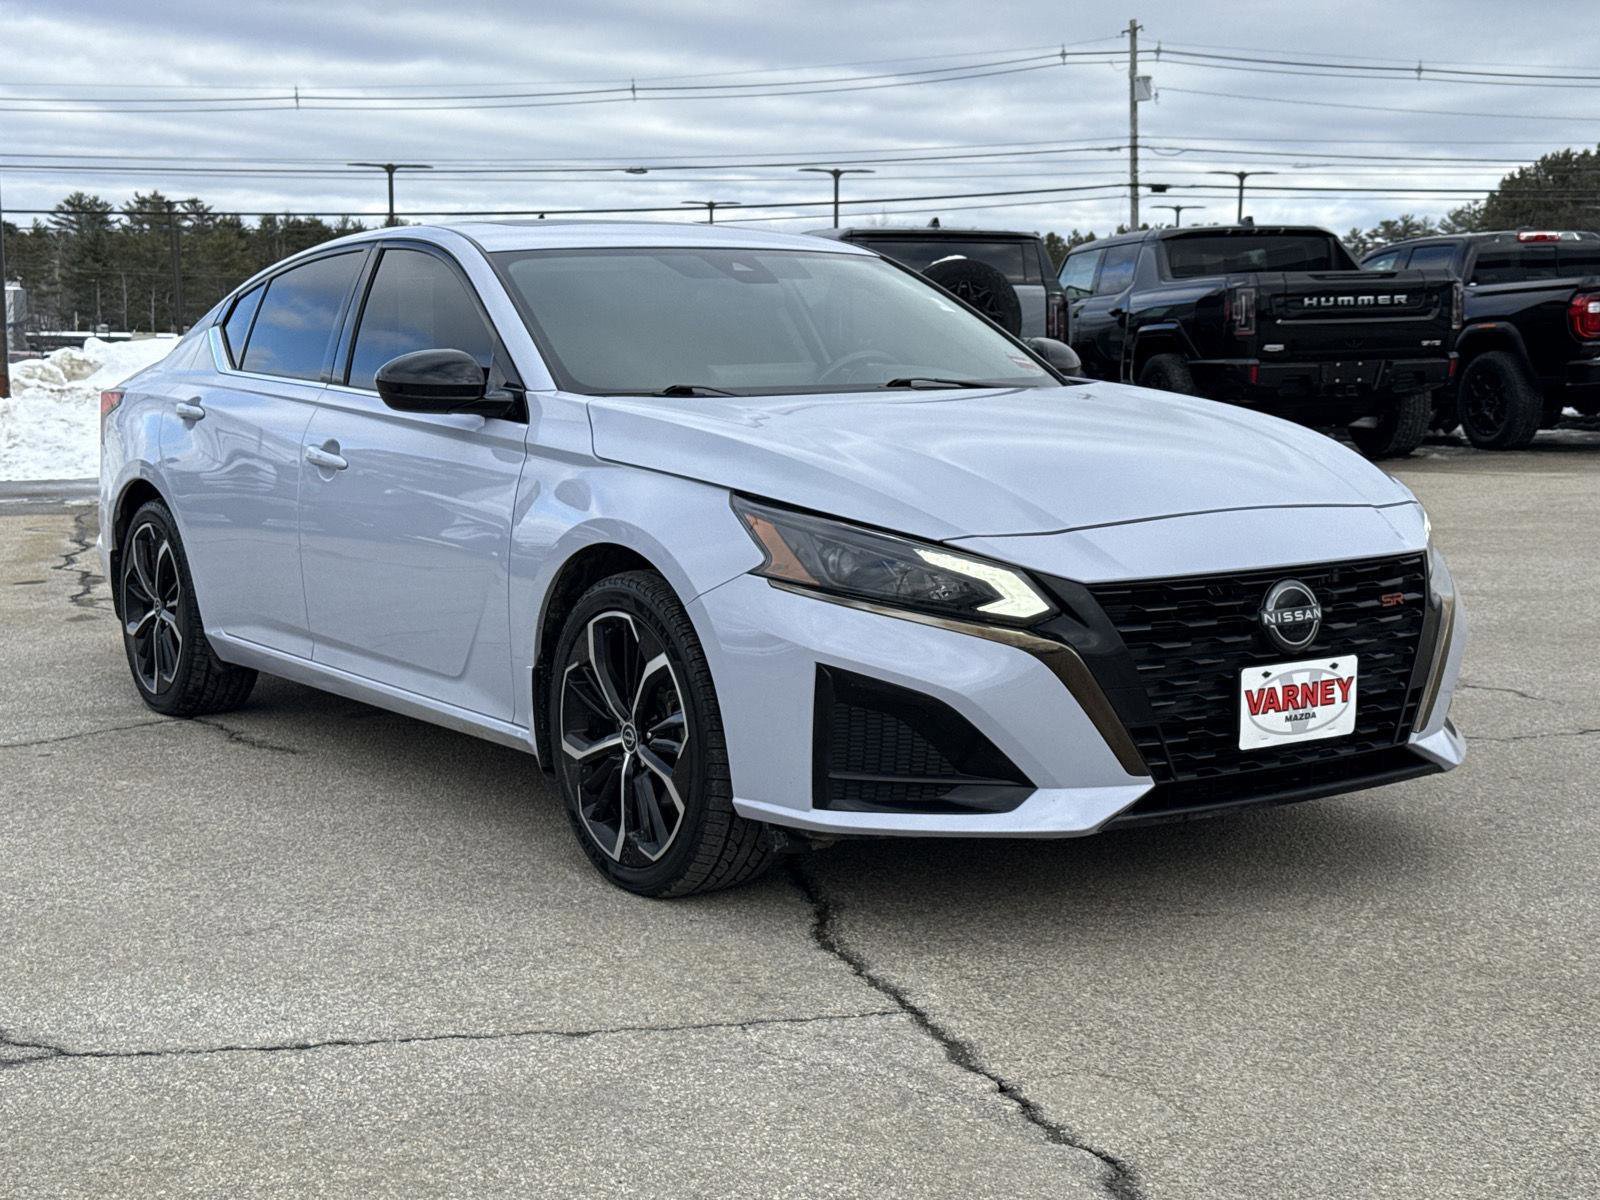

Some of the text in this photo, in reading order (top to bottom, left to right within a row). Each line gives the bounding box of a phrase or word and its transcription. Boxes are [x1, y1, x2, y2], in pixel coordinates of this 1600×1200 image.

[1303, 294, 1408, 306] HUMMER
[1263, 607, 1322, 624] NISSAN
[1244, 676, 1355, 716] VARNEY
[1284, 712, 1317, 723] MAZDA
